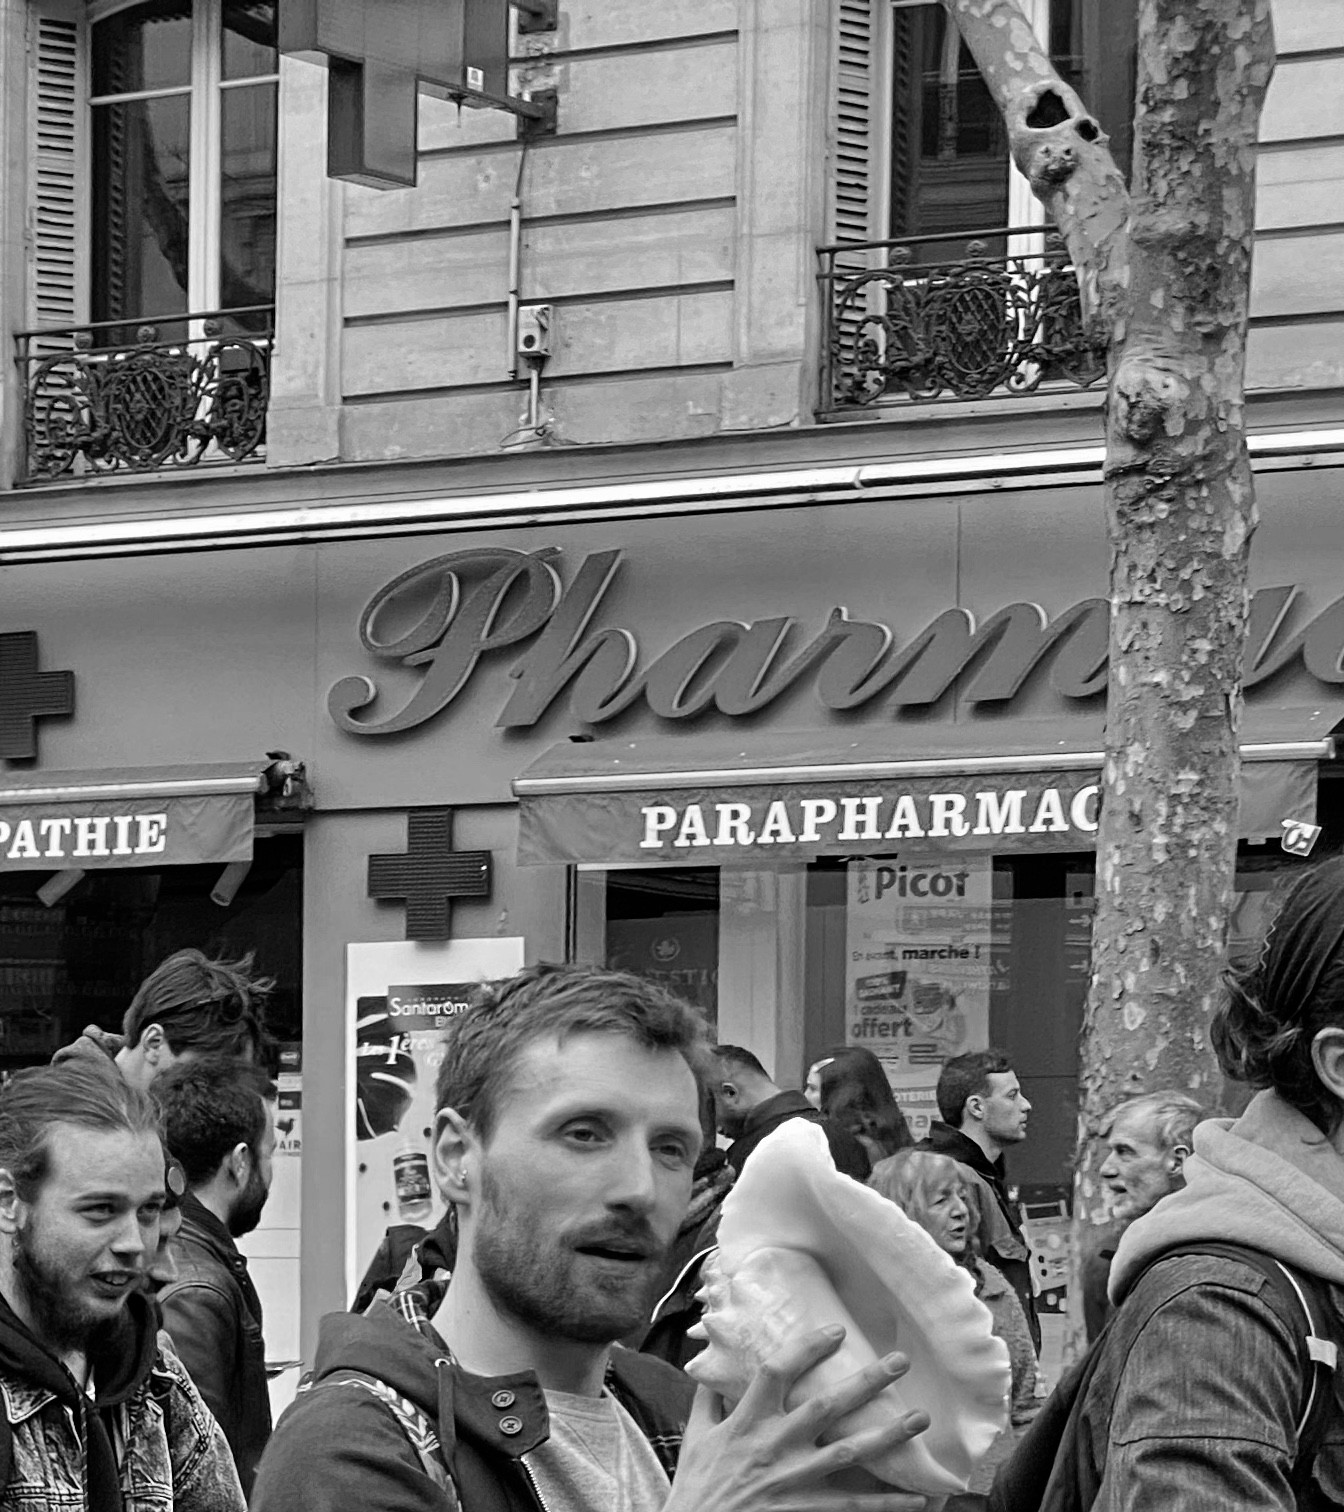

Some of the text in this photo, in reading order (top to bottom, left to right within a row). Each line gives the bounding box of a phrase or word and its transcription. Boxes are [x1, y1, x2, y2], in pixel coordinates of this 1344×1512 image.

[875, 865, 970, 900] Picot
[901, 944, 970, 960] marche
[851, 1016, 914, 1038] offert
